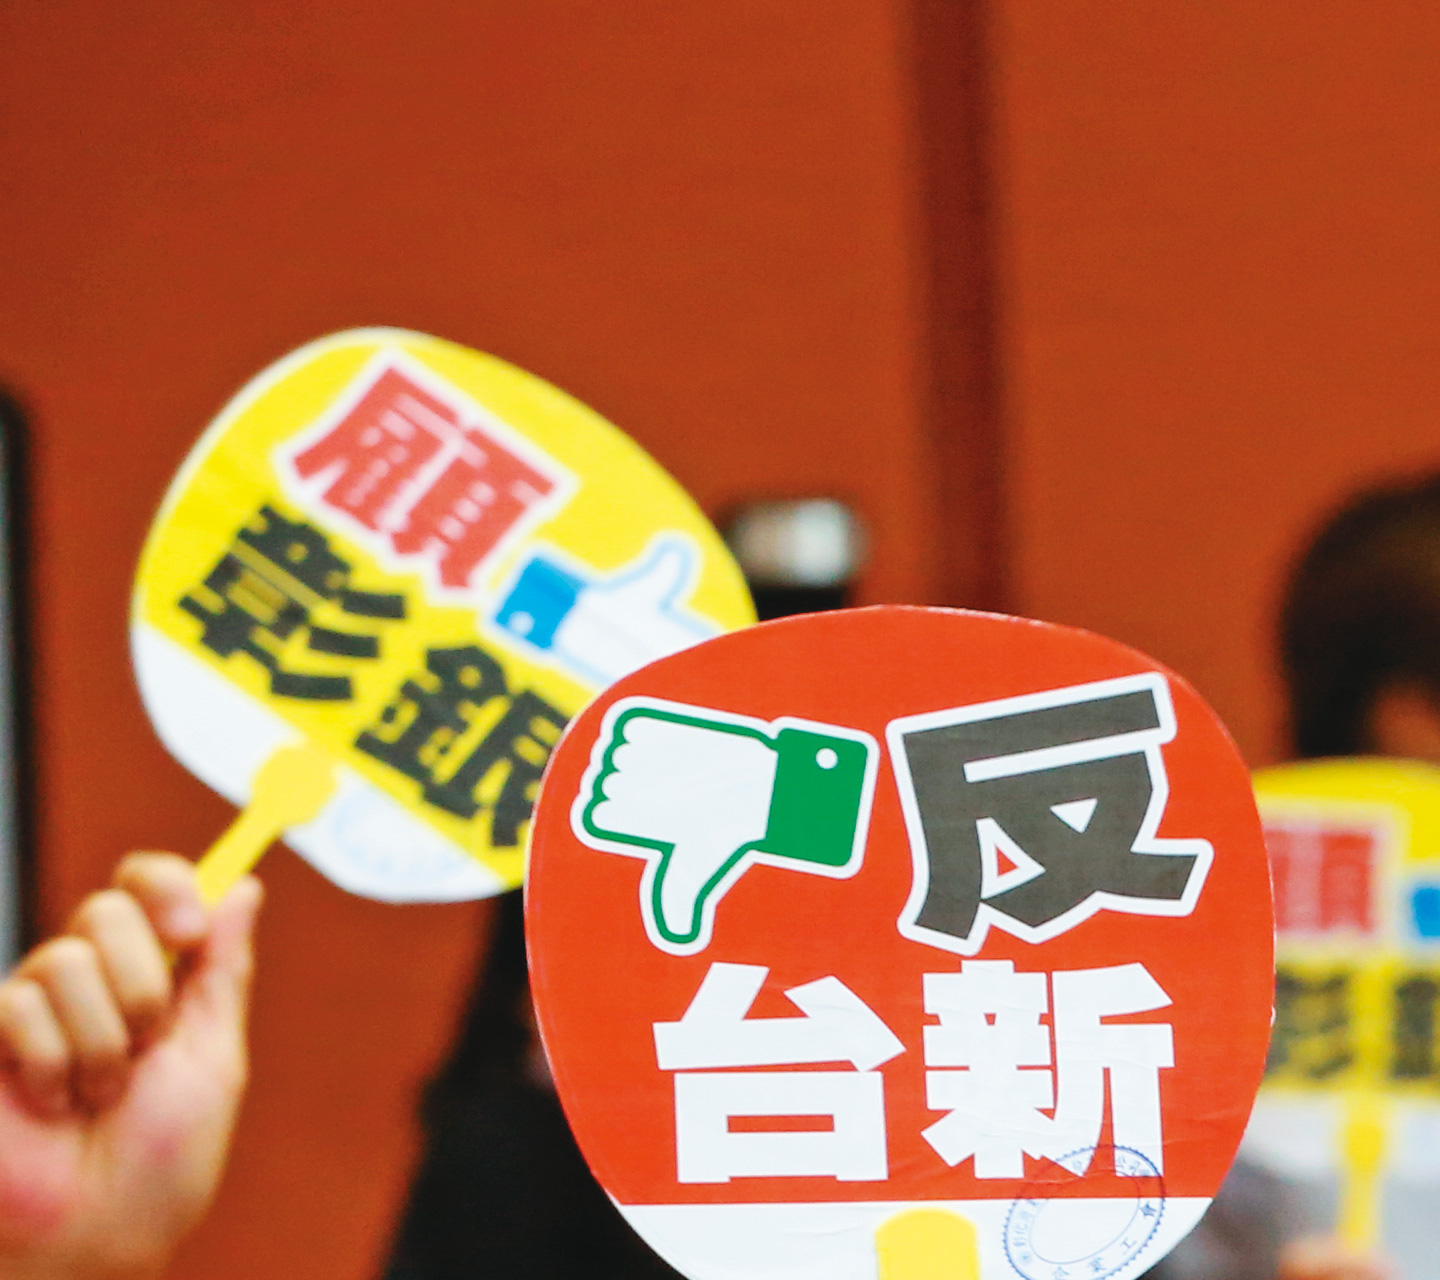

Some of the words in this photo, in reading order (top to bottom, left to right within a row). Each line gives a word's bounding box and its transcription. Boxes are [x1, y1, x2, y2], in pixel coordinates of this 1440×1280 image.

[292, 360, 556, 590] 顧
[897, 687, 1200, 941] 反
[652, 960, 1175, 1185] 台新
